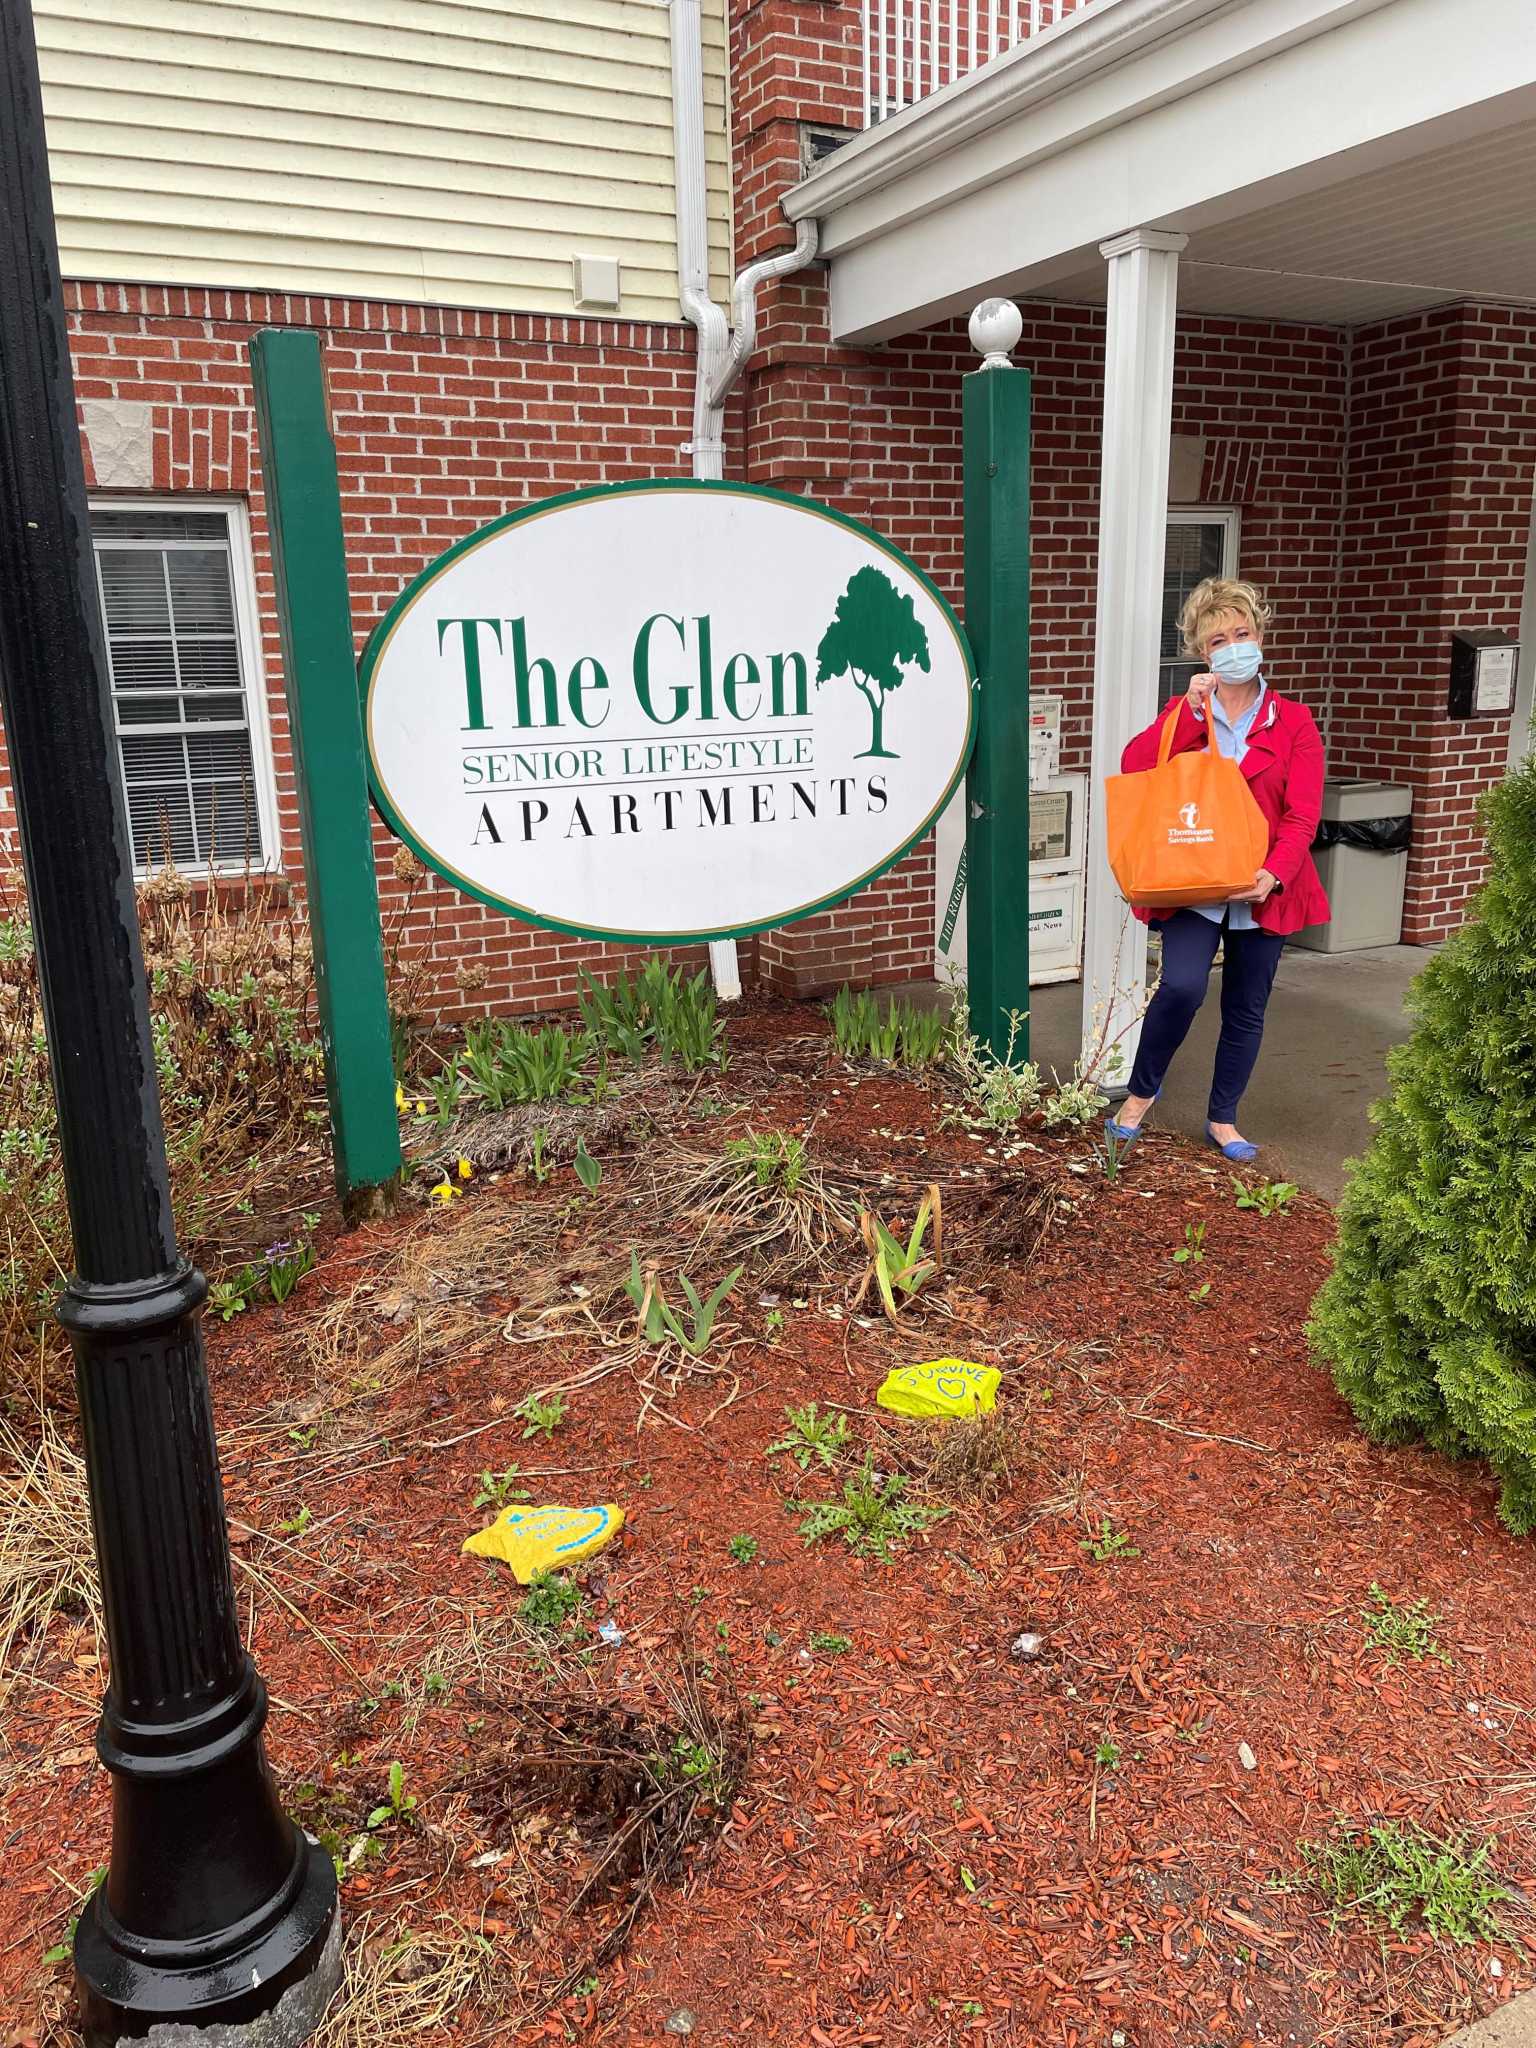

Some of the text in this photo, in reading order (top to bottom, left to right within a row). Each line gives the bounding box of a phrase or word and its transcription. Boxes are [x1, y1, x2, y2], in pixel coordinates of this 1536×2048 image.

[437, 613, 814, 731] The Glen
[462, 737, 815, 785] SENIOR LIFESTYLE
[469, 775, 889, 846] APARTMENTS
[941, 919, 955, 941] THE
[1043, 922, 1062, 930] News
